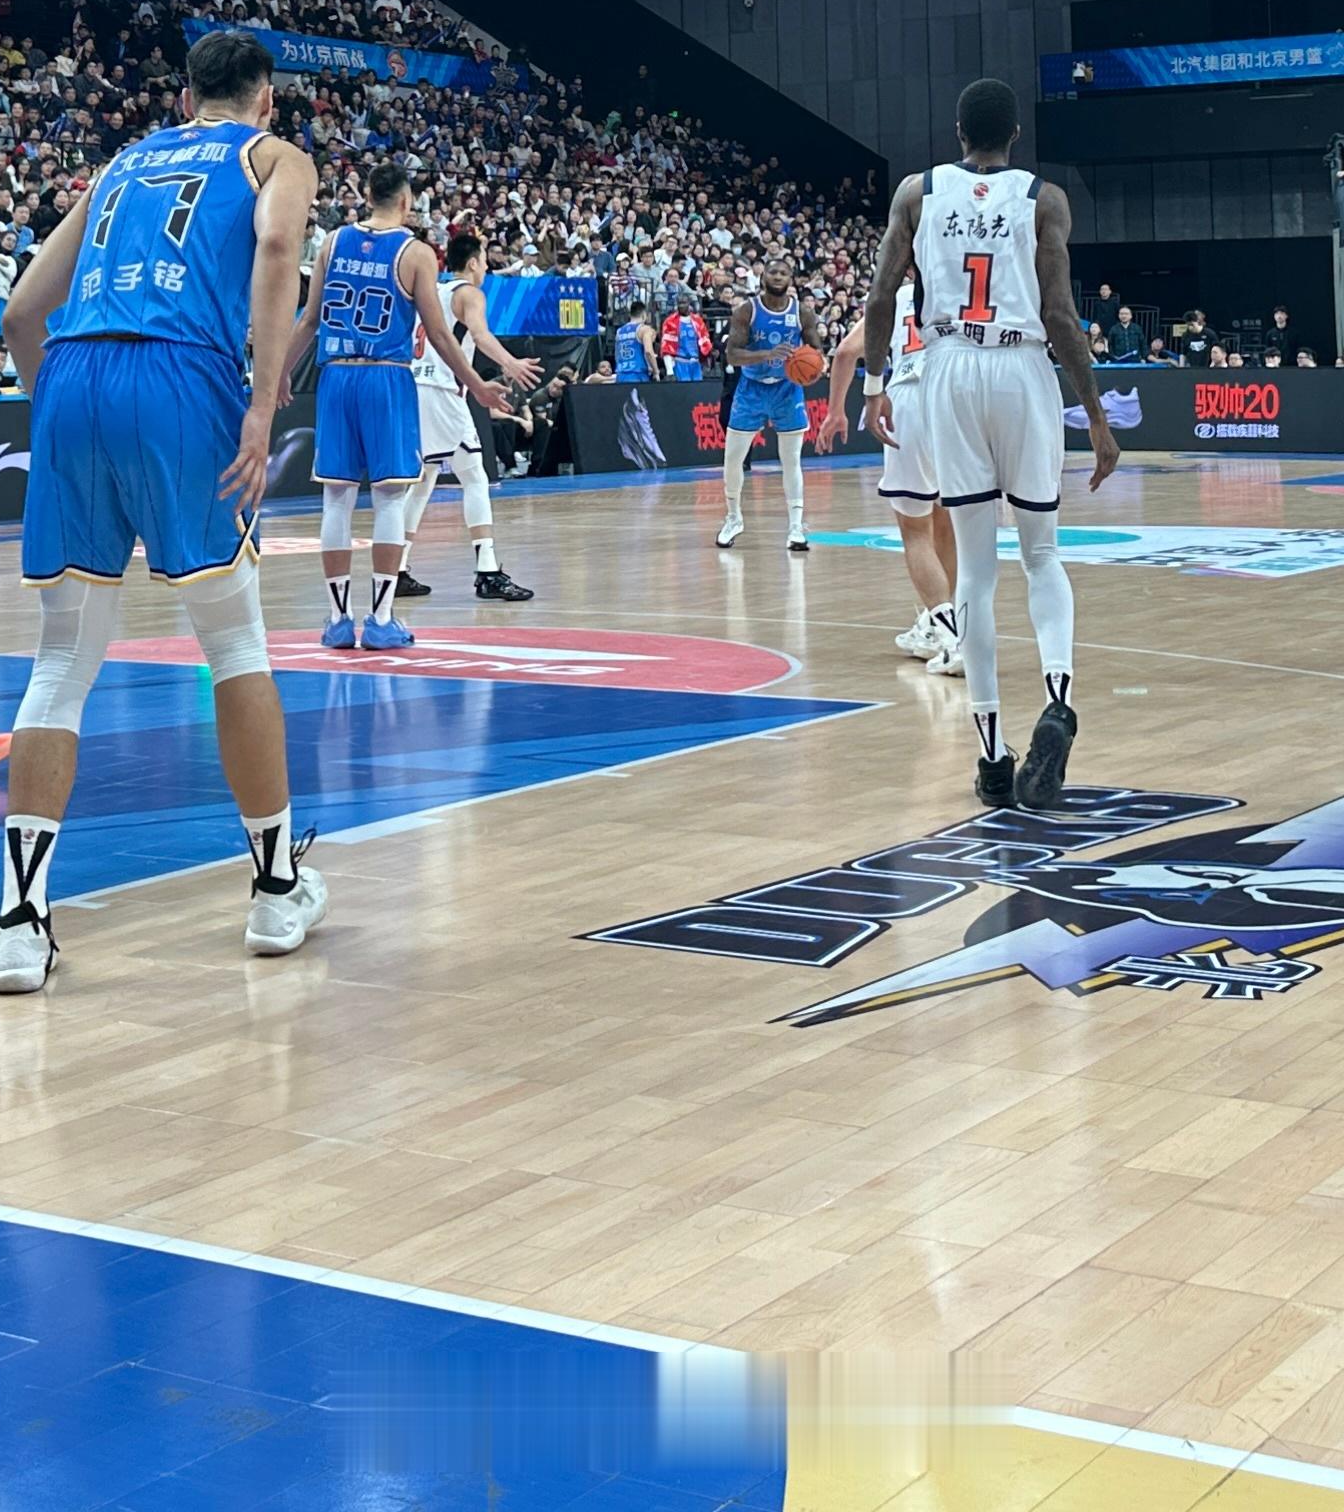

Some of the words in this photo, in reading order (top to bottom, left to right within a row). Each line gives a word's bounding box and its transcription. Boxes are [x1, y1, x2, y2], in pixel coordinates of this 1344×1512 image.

[281, 39, 367, 70] 为北京而战
[1171, 46, 1322, 75] 北汽集团和北京男篮
[114, 142, 232, 176] 北汽极狐
[92, 171, 208, 249] 17
[81, 260, 187, 303] 范子铭
[959, 252, 997, 323] 1
[321, 280, 394, 335] 20
[1195, 383, 1280, 419] 驭帅20
[578, 785, 1246, 967] DUCKS
